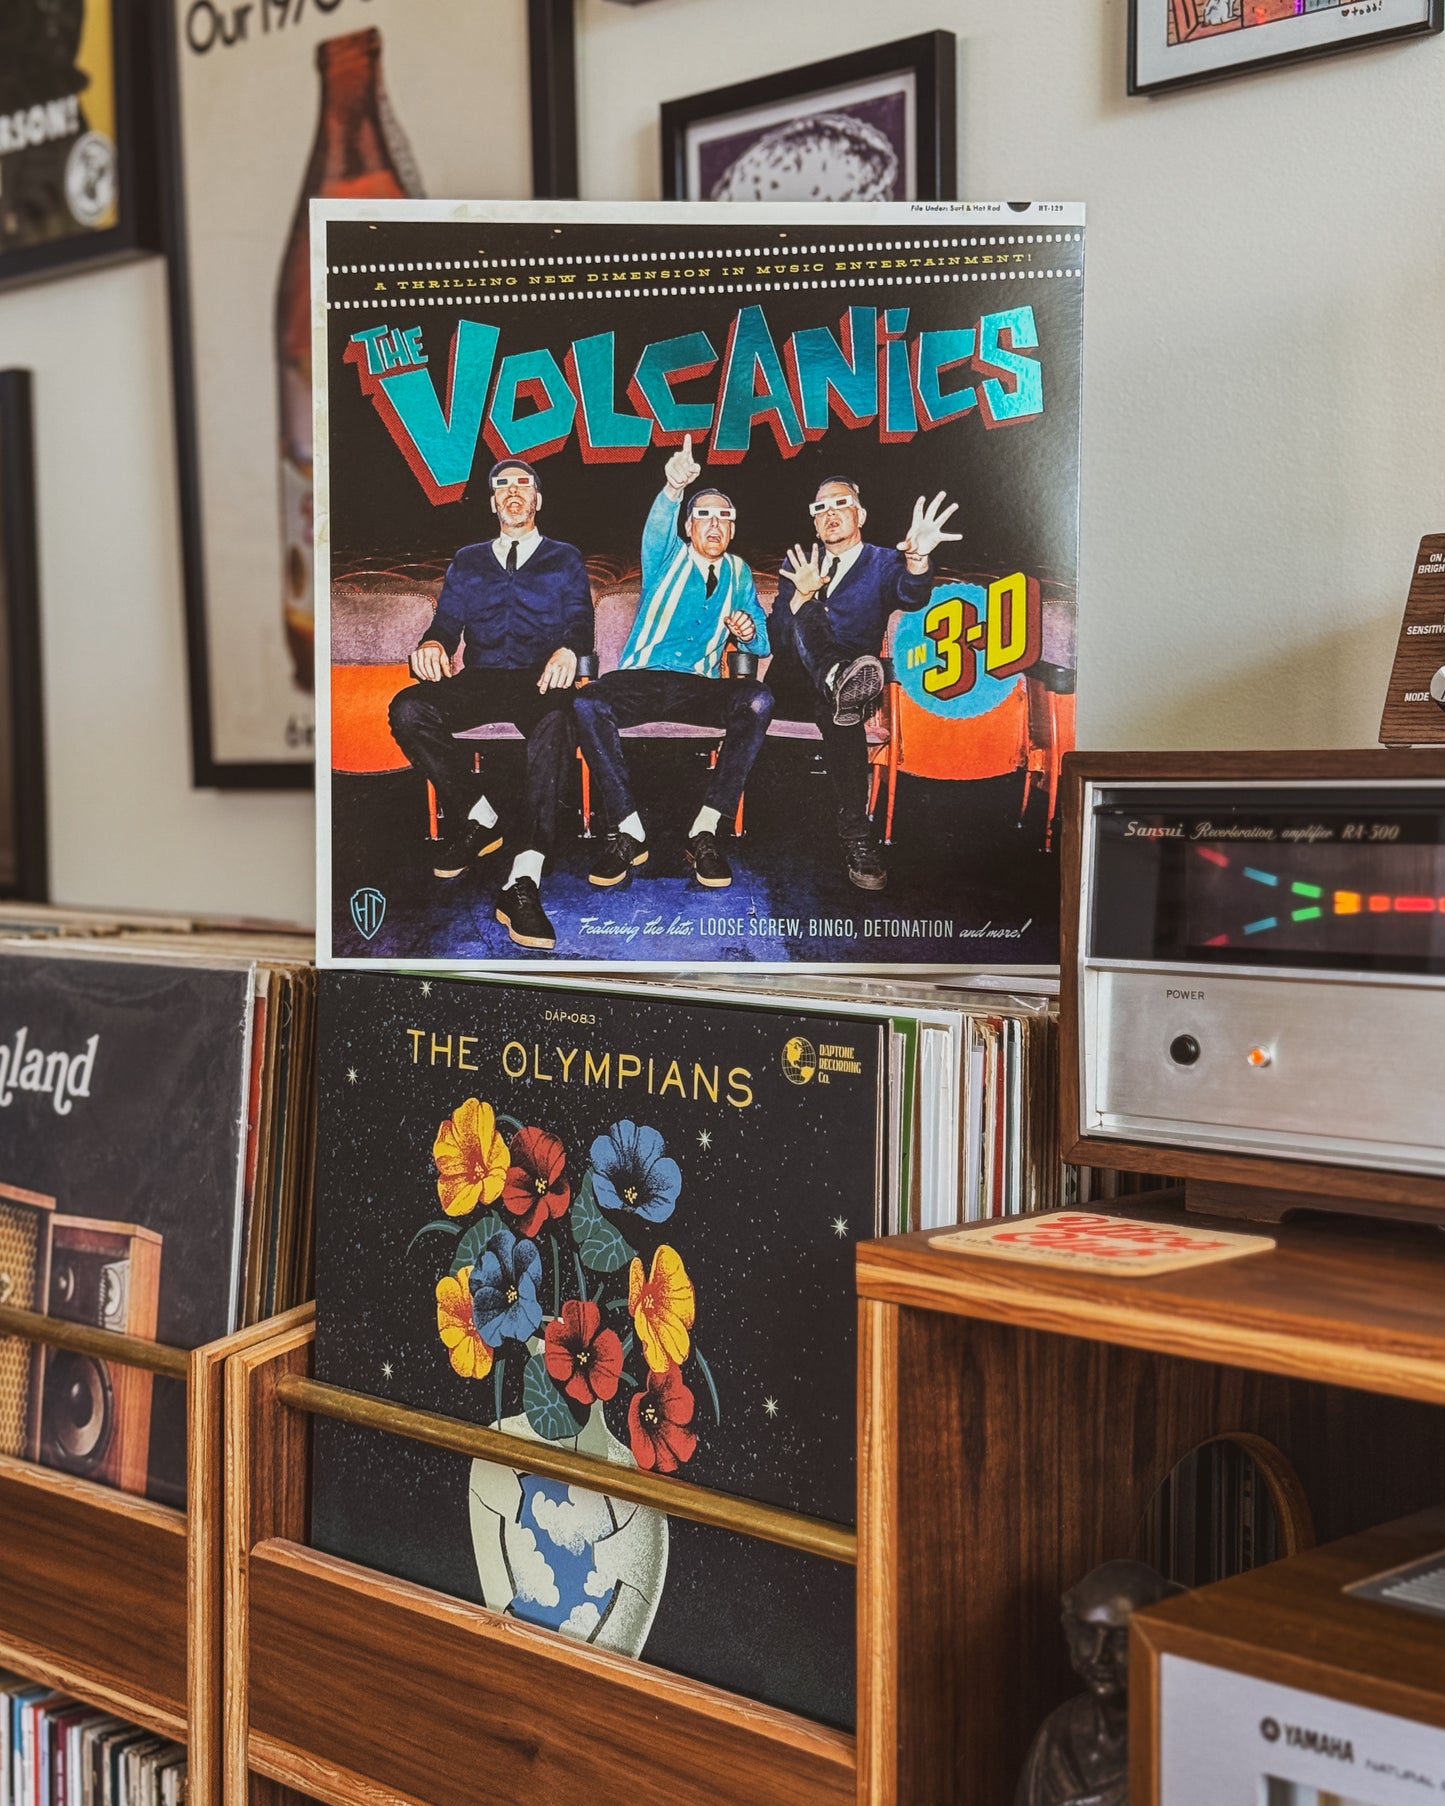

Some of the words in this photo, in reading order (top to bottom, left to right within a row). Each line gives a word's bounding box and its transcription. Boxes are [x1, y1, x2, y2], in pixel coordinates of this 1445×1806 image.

[186, 0, 253, 55] Our
[910, 204, 923, 212] File
[925, 204, 948, 212] Under:
[950, 204, 964, 212] Surf
[965, 204, 972, 212] &
[973, 204, 986, 212] Hot
[987, 204, 1001, 212] Rod
[374, 282, 387, 291] A
[397, 276, 518, 290] THRILLING
[528, 274, 577, 285] NEW
[587, 268, 712, 282] DIMENSION
[722, 266, 745, 276] IN
[756, 263, 825, 274] MUSIC
[835, 253, 1033, 271] ENTERTAINMENT!
[348, 325, 429, 376] THE
[1429, 553, 1443, 563] ON
[906, 643, 928, 670] IN
[923, 571, 1040, 700] 3-D
[1404, 692, 1430, 702] MODE
[1124, 821, 1185, 837] Sansui
[1281, 824, 1335, 843] amplifier
[578, 916, 640, 943] Featuring
[643, 915, 666, 935] the
[699, 917, 745, 936] LOOSE
[749, 918, 803, 939] SCREW,
[809, 918, 858, 940] BINGO,
[864, 919, 954, 938] DETONATION
[959, 920, 992, 938] and
[987, 918, 1033, 938] more!
[1166, 989, 1205, 1000] POWER
[819, 1044, 855, 1059] DAPTONE
[406, 1028, 479, 1071] THE
[502, 1040, 754, 1108] OLYMPIANS
[818, 1057, 862, 1074] RECORDING
[818, 1071, 831, 1084] Co.
[1283, 1723, 1355, 1764] YAMAHA
